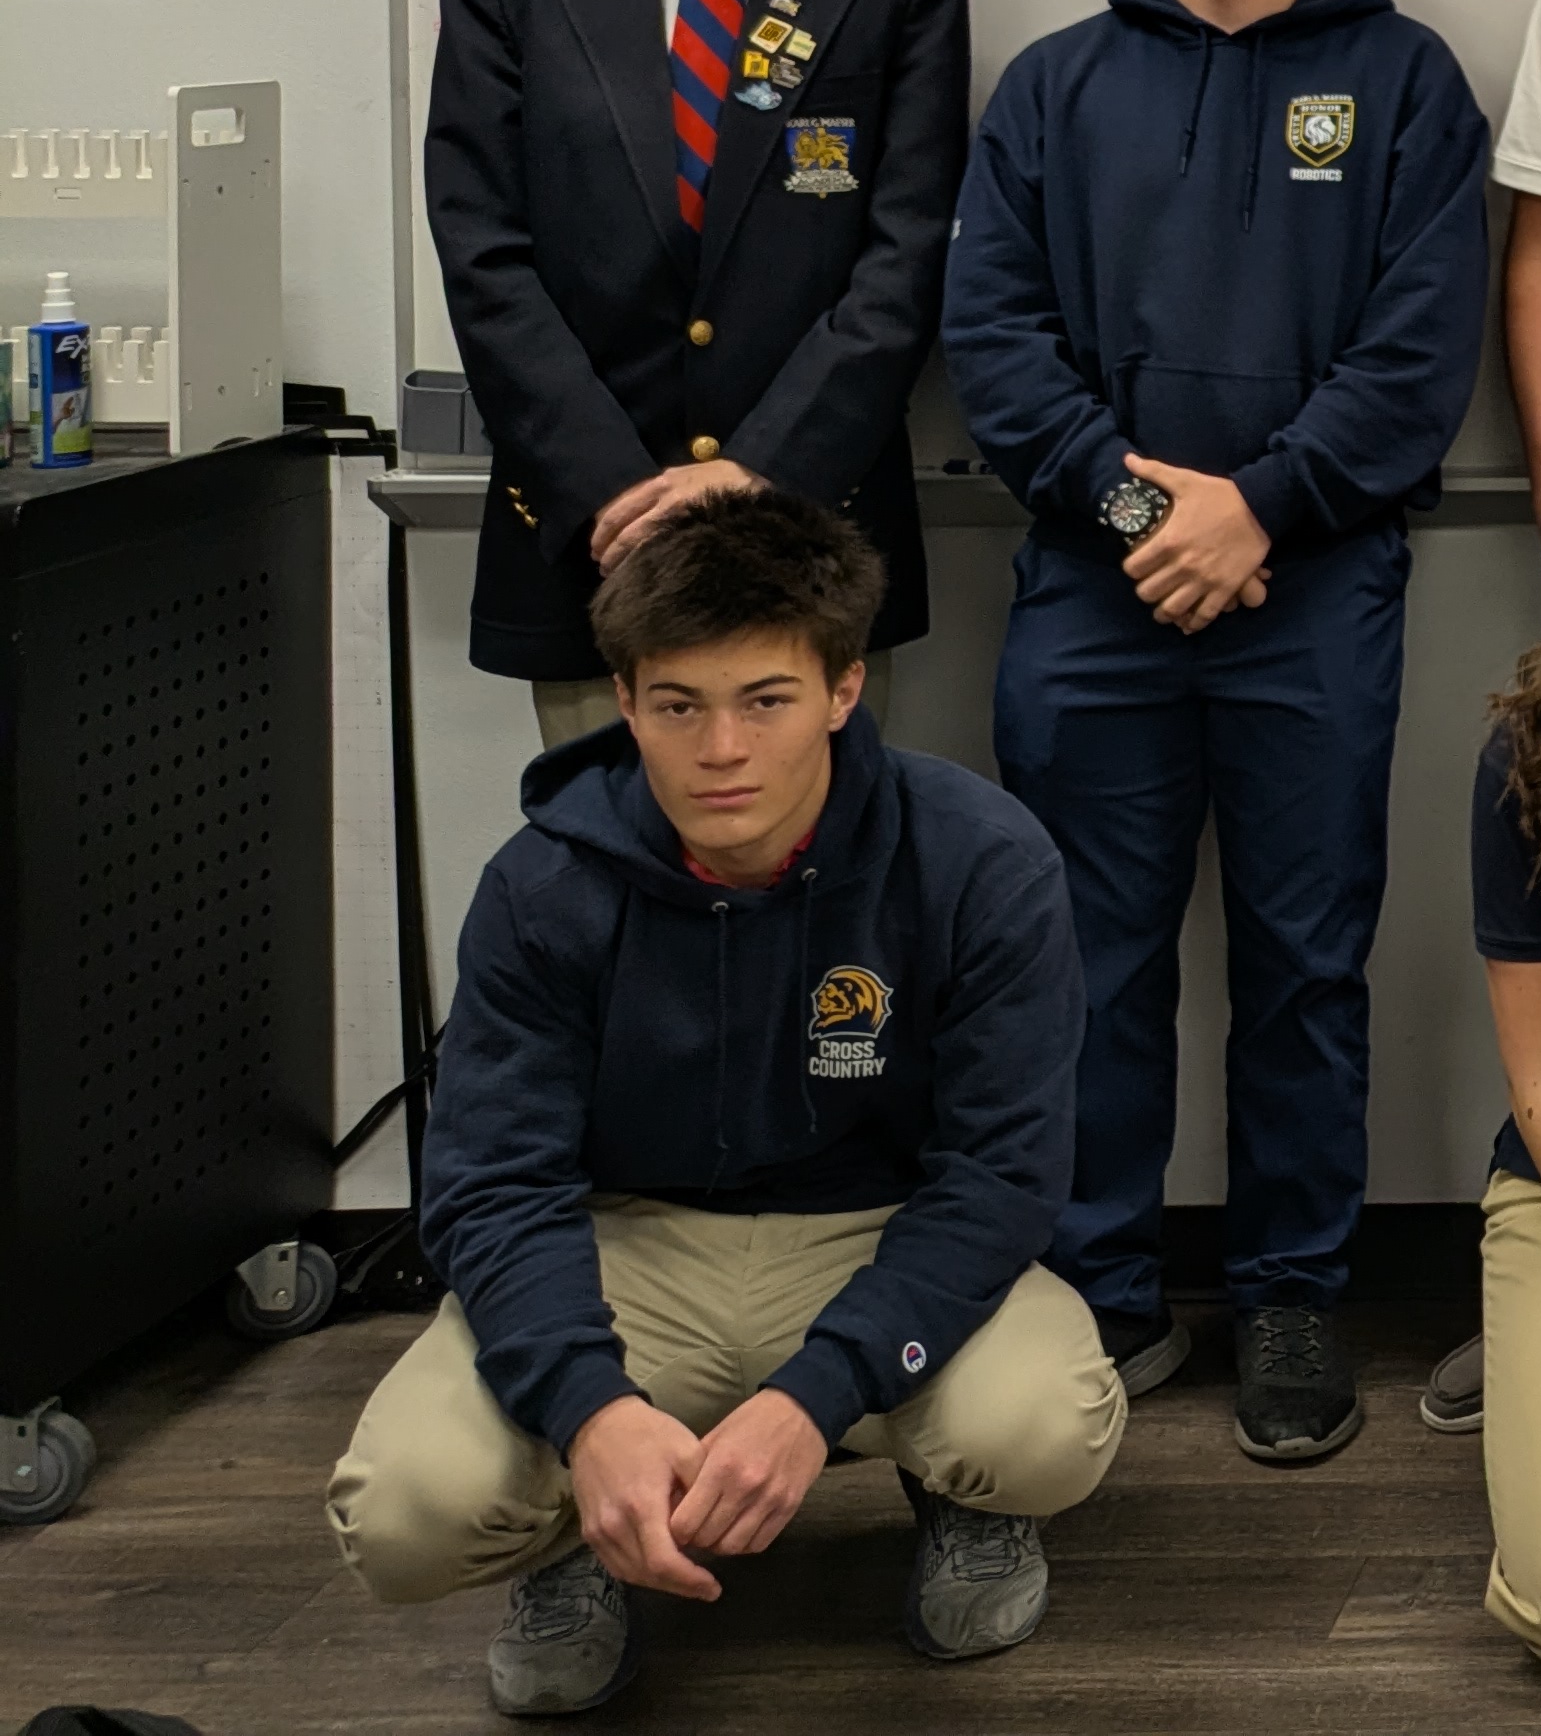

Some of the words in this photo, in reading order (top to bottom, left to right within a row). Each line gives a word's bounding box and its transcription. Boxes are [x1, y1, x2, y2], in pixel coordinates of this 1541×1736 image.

[1290, 168, 1342, 182] ROBOTICS
[819, 1041, 875, 1058] CROSS
[809, 1057, 886, 1078] COUNTRY
